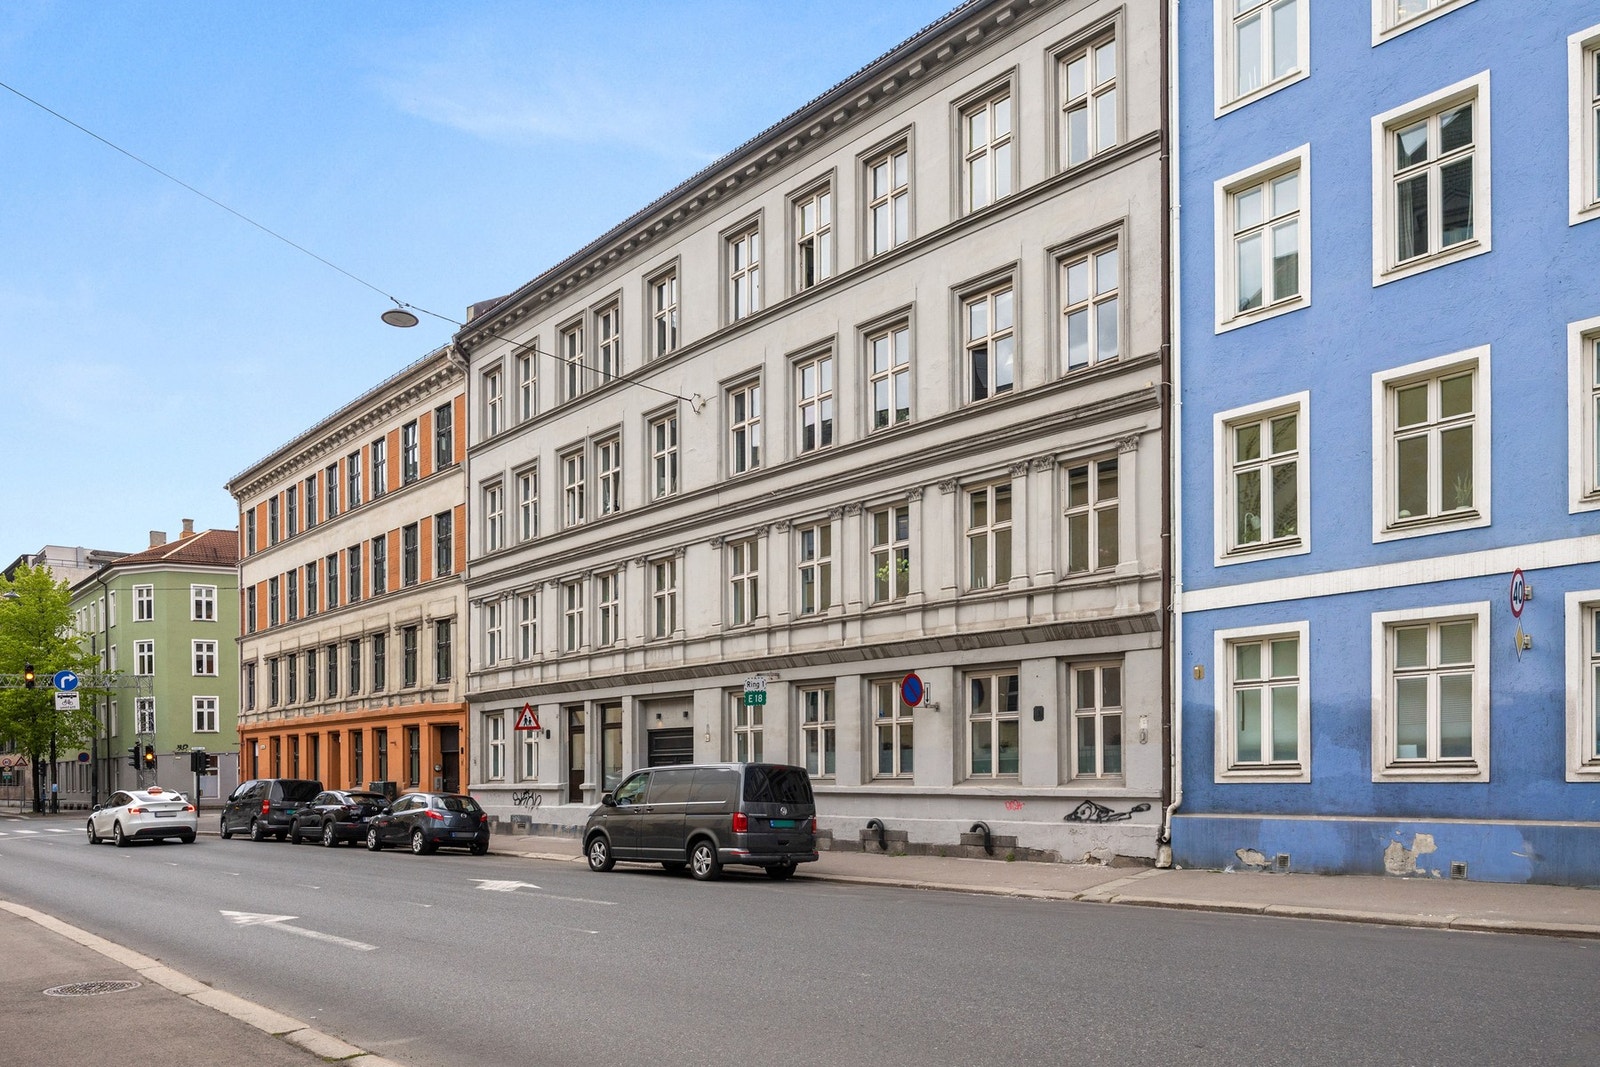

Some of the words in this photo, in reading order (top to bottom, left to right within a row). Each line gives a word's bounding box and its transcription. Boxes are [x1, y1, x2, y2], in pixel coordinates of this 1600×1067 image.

[1513, 580, 1523, 604] 40
[746, 680, 760, 689] Ring
[748, 694, 753, 703] E
[755, 694, 763, 703] 18
